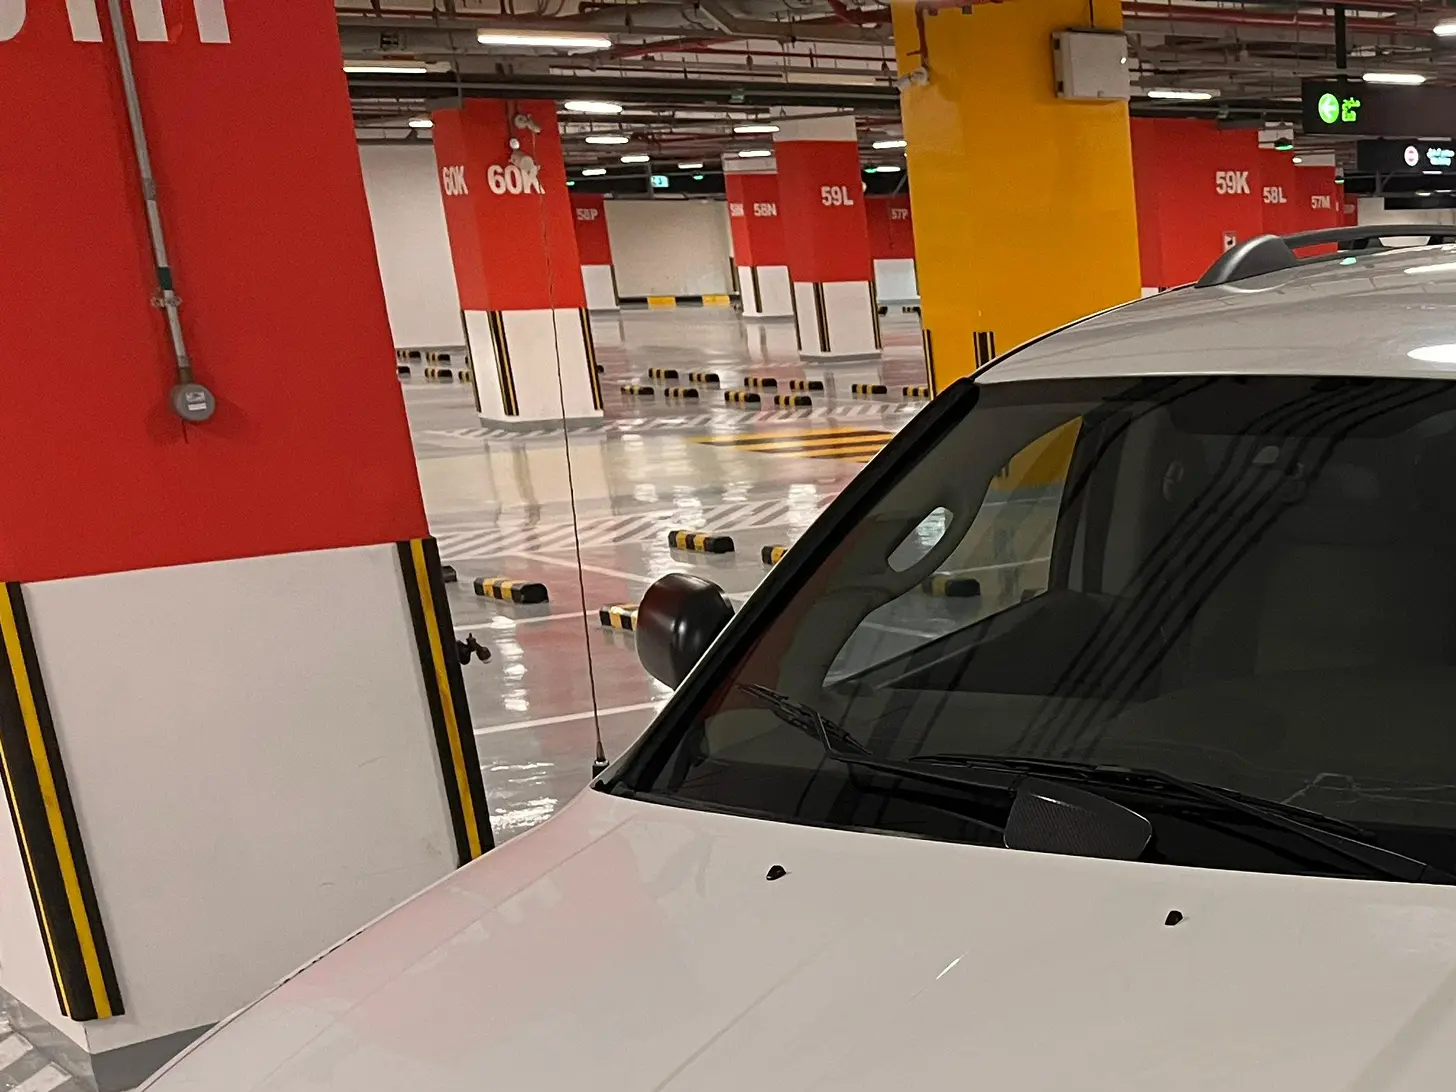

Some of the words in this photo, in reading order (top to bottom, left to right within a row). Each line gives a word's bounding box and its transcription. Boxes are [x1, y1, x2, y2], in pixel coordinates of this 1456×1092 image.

[442, 165, 469, 196] 60K
[487, 164, 546, 195] 60K
[1215, 170, 1251, 194] 59K
[820, 186, 854, 207] 59L
[1263, 186, 1287, 204] 58L
[1311, 195, 1331, 209] 57M
